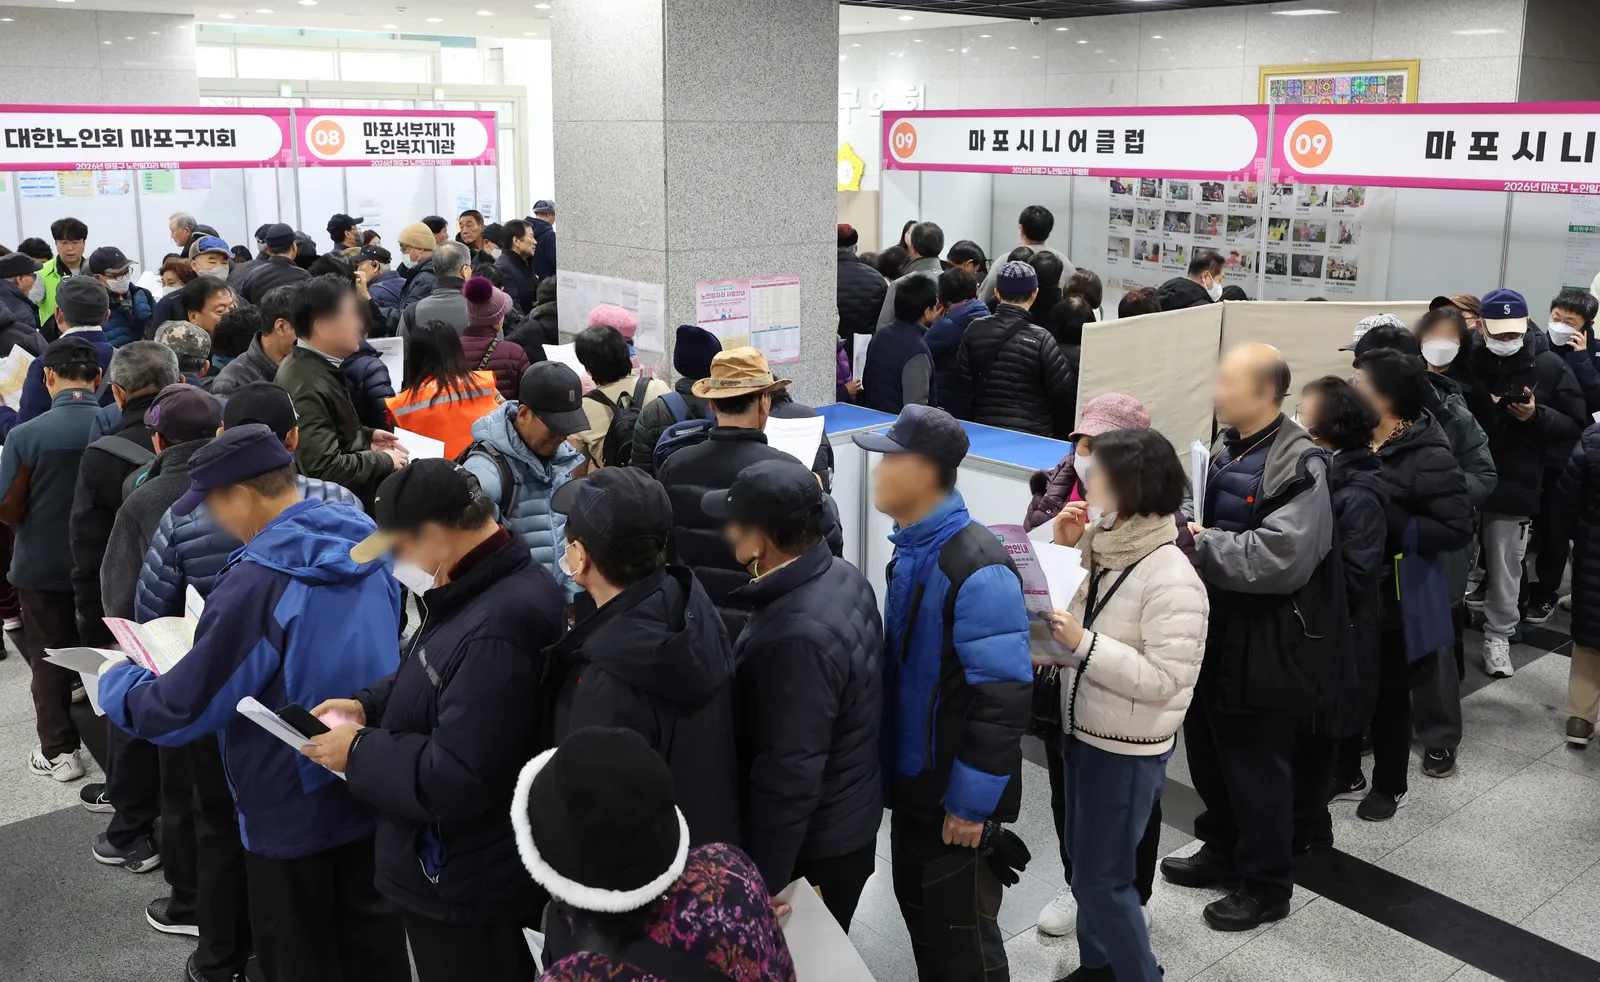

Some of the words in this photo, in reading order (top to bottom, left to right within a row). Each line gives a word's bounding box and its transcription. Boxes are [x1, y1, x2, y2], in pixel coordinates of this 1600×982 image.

[4, 127, 124, 149] 대한노인회
[130, 128, 236, 148] 마포구지회
[314, 129, 341, 147] 08
[363, 121, 456, 138] 마포서부재가
[365, 139, 456, 155] 노인복지기관
[895, 131, 915, 149] 09
[1295, 132, 1328, 155] 09
[75, 162, 103, 170] 2026년
[1503, 182, 1539, 192] 2026년
[1541, 183, 1569, 193] 마포구
[1570, 184, 1600, 194] 노인일
